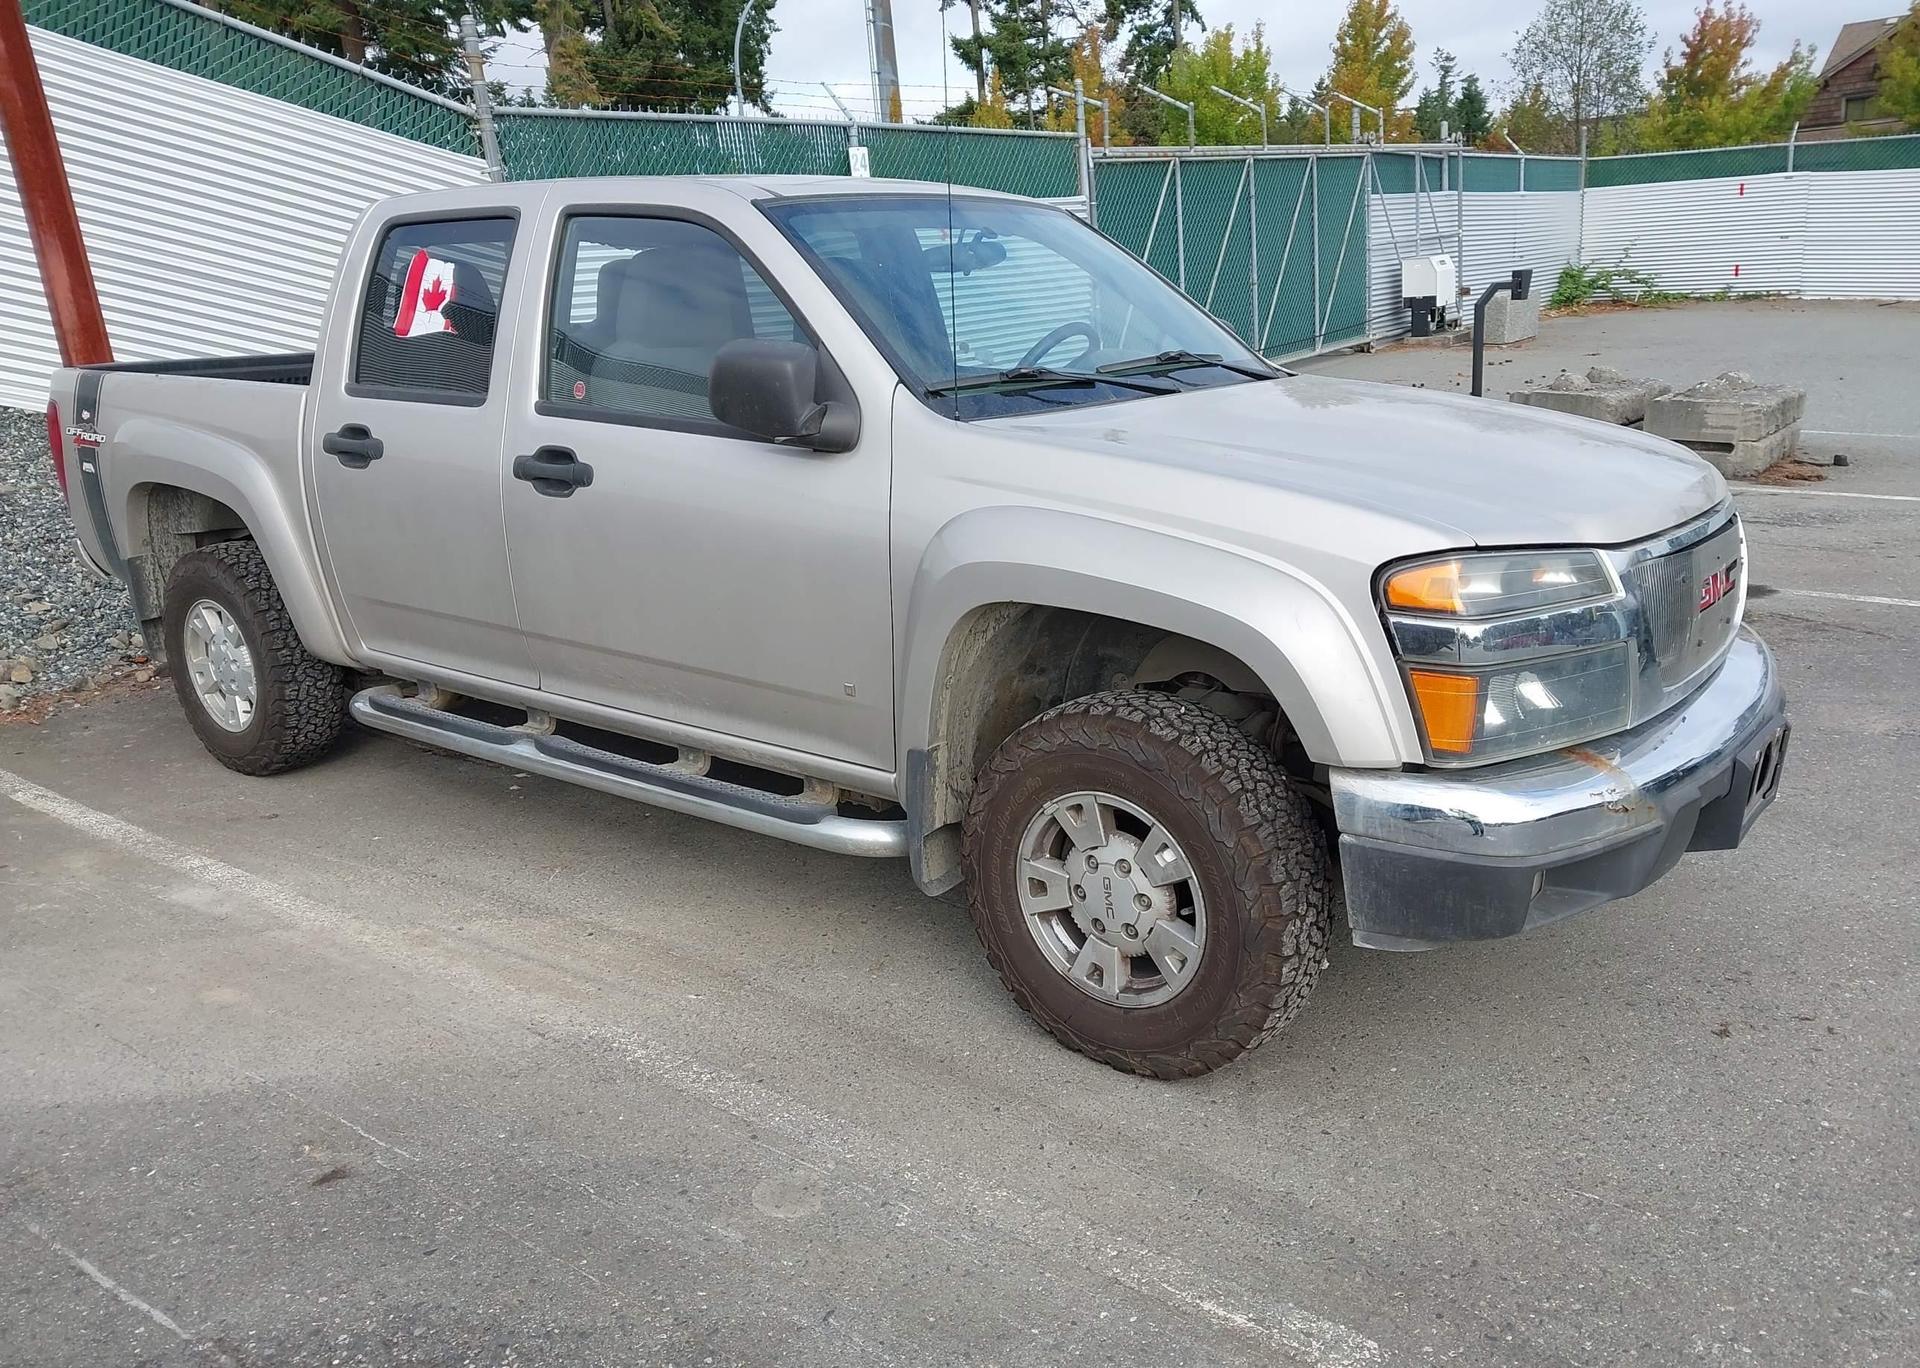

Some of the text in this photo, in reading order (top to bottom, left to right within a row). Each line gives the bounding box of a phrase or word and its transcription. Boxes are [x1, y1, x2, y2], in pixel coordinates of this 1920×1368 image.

[851, 152, 868, 172] 24
[1697, 558, 1738, 614] GMC
[1102, 876, 1115, 920] GMC
